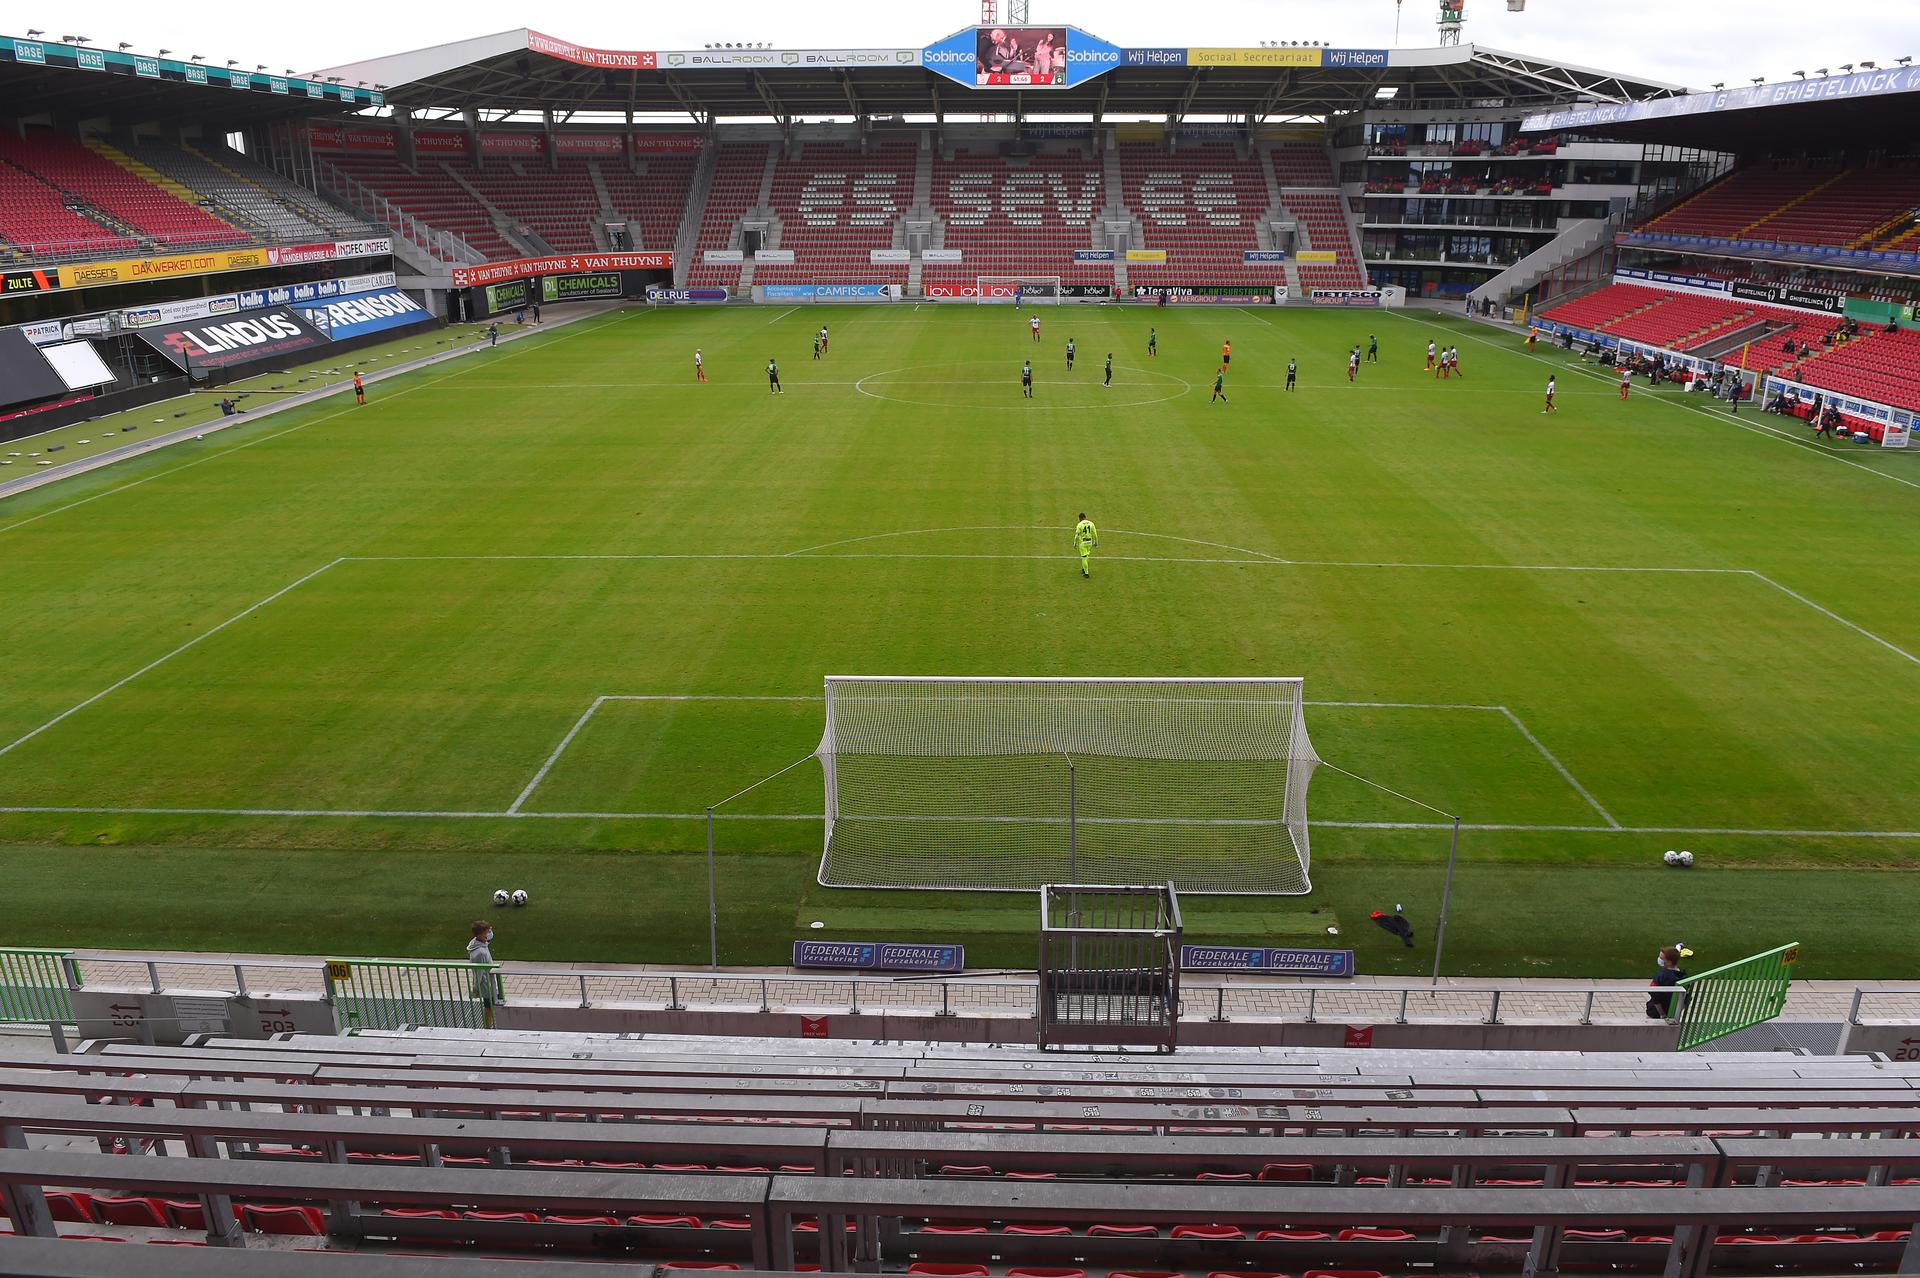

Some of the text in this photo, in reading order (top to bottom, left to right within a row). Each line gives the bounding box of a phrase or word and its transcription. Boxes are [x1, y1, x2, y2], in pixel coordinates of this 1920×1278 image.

[18, 45, 42, 59] BASE
[581, 51, 638, 65] VAN THUYNE
[924, 50, 975, 63] Sobinco
[1067, 50, 1119, 63] Sobinco
[1198, 53, 1313, 63] Sociaal Secretariaat
[80, 53, 102, 66] BASE
[692, 56, 774, 64] BALLROOM
[807, 54, 889, 63] BALLROOM
[1128, 52, 1182, 65] Wij Helpen
[1330, 52, 1384, 65] Wij Helpen
[137, 61, 157, 73] BASE
[187, 68, 205, 80] BASE
[232, 75, 248, 86] BASE
[272, 81, 287, 92] BASE
[1773, 72, 1903, 102] GHISTELINCK
[1552, 107, 1616, 127] GHISTELINCK
[421, 137, 453, 146] THUYNE
[496, 139, 530, 148] THUYNE
[556, 139, 612, 148] VAN THUYNE
[638, 139, 692, 148] VAN THUYNE
[228, 254, 259, 266] NAESSENS
[1079, 251, 1109, 260] Wij Helpen
[1249, 252, 1280, 260] Wij Helpen
[520, 260, 567, 274] VAN THUYNE
[584, 256, 664, 268] VAN THUYNE
[73, 267, 118, 282] NAESSENS
[477, 267, 513, 281] VAN THUYNE
[7, 277, 34, 290] ZULTE
[370, 274, 395, 288] CARLIER
[544, 280, 557, 292] DL
[558, 276, 618, 290] CHEMICALS
[293, 286, 314, 299] balko
[318, 283, 337, 296] balko
[496, 284, 525, 300] CHEMICALS
[649, 291, 690, 300] DELRUE
[1147, 286, 1193, 296] TeraViva
[1736, 287, 1768, 297] GHISTELINCK
[240, 293, 264, 307] balko
[268, 289, 290, 303] balko
[1789, 295, 1824, 306] GHISTELINCK
[335, 291, 422, 323] RENSON
[33, 325, 59, 336] PATRICK
[183, 314, 302, 353] LINDUS
[1082, 525, 1091, 535] 41
[803, 945, 861, 956] FEDERALE
[883, 948, 941, 959] FEDERALE
[1192, 950, 1249, 961] FEDERALE
[803, 954, 858, 964] Verzekering
[883, 957, 939, 966] Verzekering
[1273, 953, 1331, 964] FEDERALE
[328, 964, 347, 978] 106
[261, 1020, 296, 1032] 203
